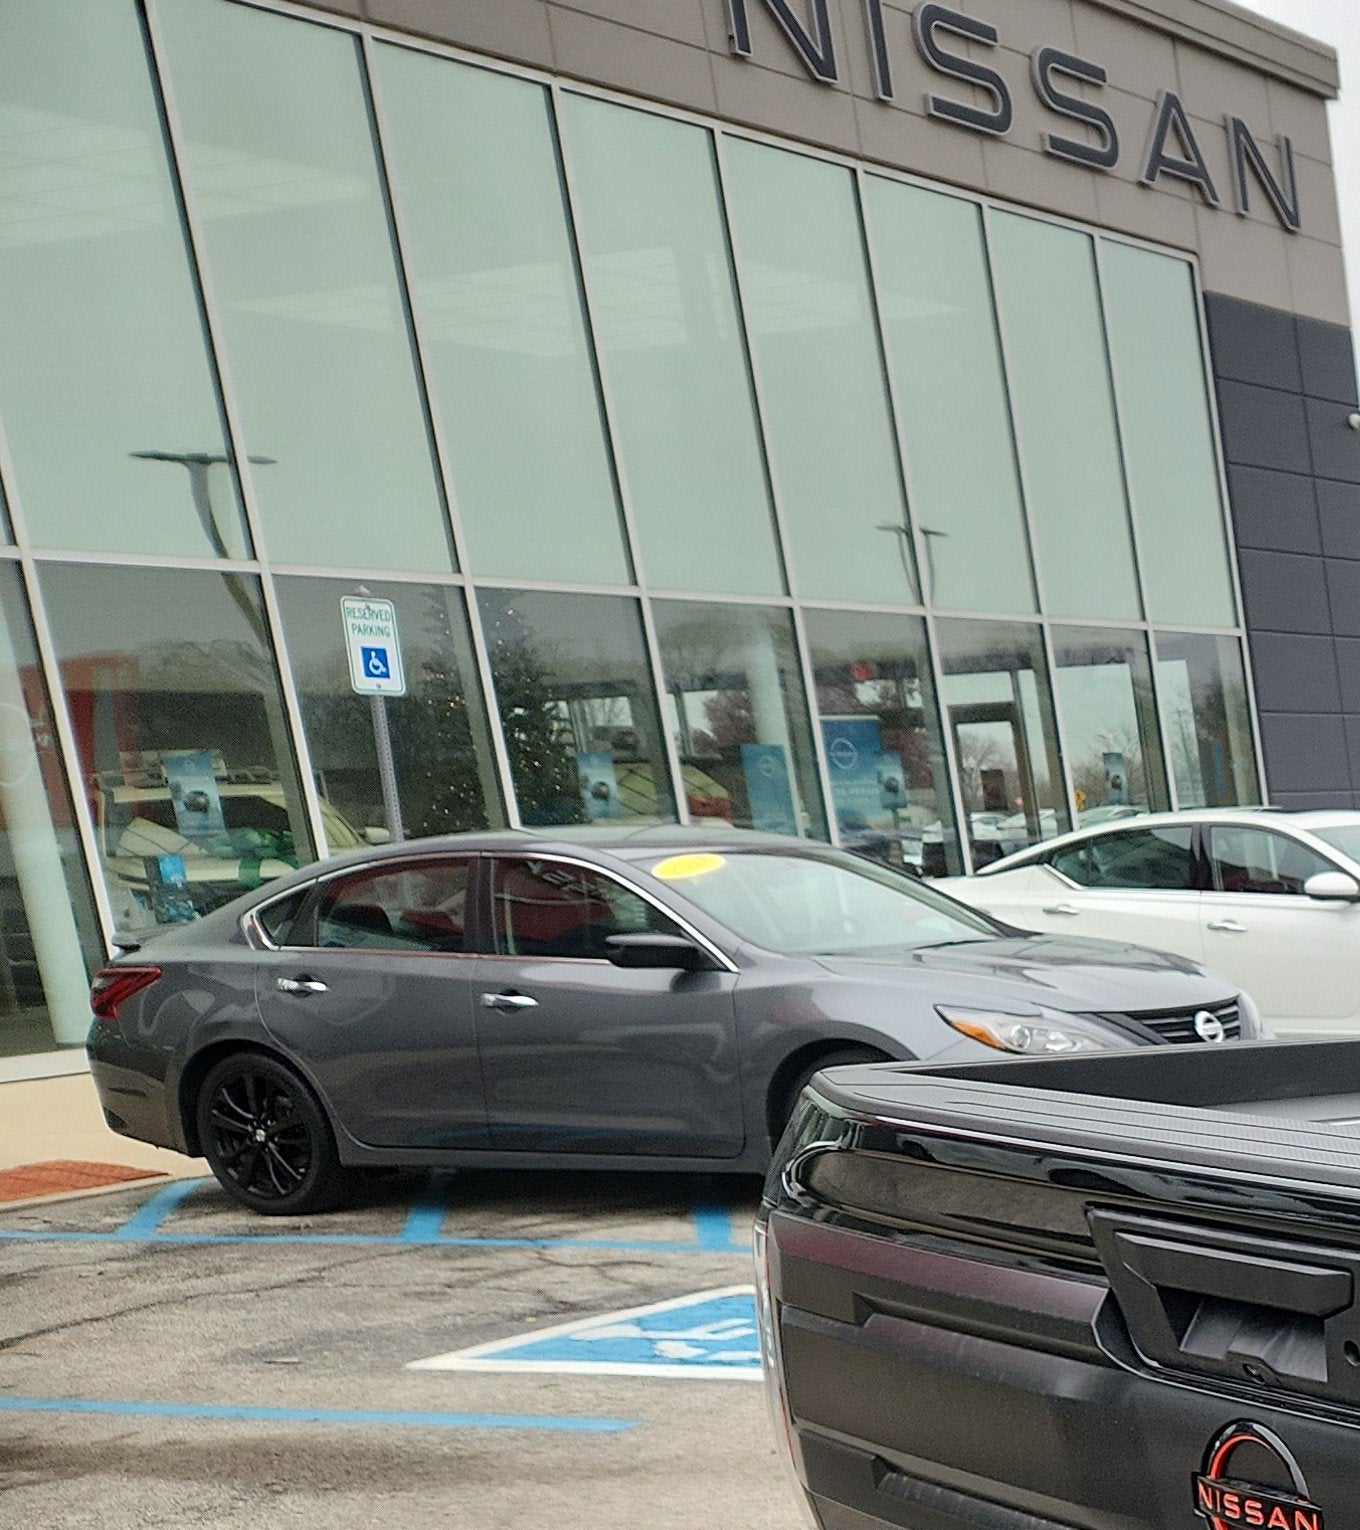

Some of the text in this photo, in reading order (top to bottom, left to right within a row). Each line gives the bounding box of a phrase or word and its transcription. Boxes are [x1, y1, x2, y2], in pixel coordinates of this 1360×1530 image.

[726, 0, 1300, 234] NISSAN
[346, 607, 391, 621] RESERVED
[351, 623, 391, 638] PARKING
